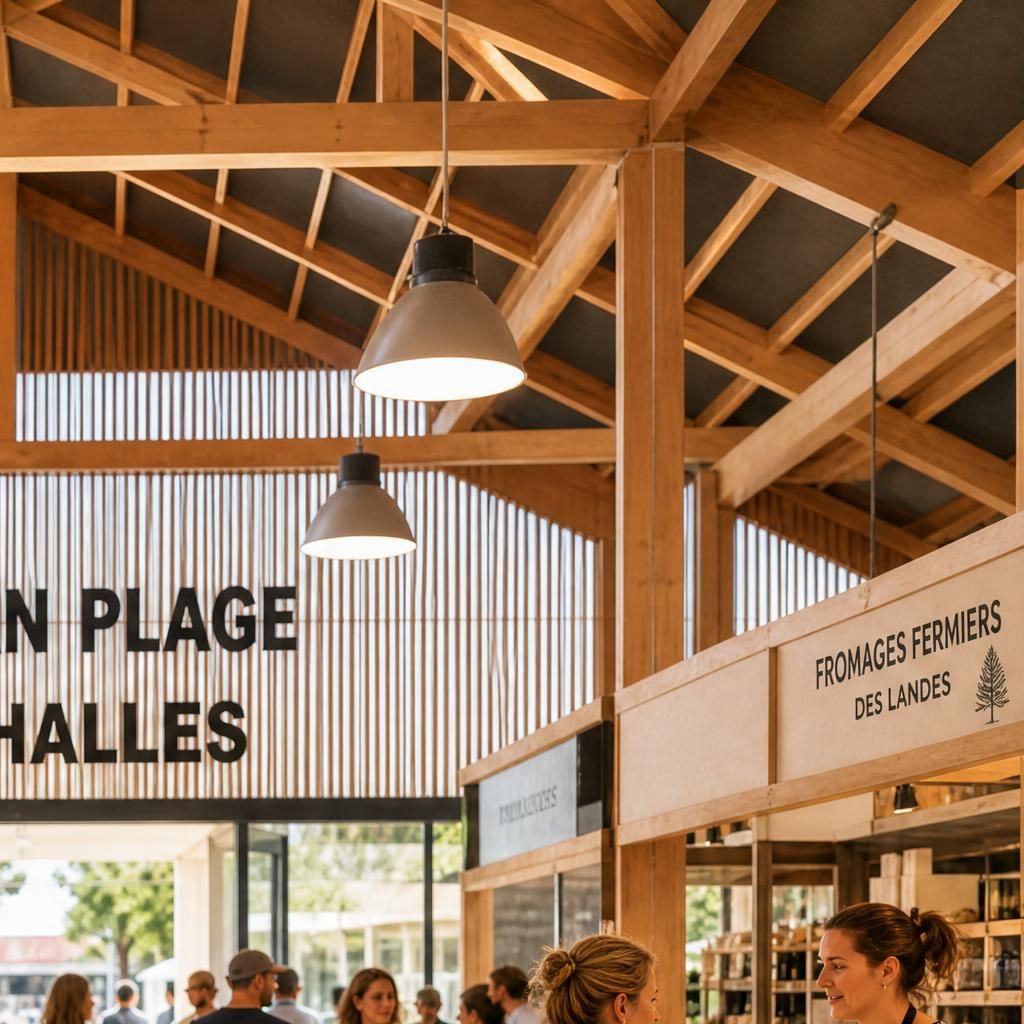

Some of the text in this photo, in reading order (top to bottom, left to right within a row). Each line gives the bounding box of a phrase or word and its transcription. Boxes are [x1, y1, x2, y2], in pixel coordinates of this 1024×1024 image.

[80, 585, 298, 653] PLAGE
[815, 599, 1002, 690] FROMAGES FERMIERS
[854, 671, 951, 721] DES LANDES
